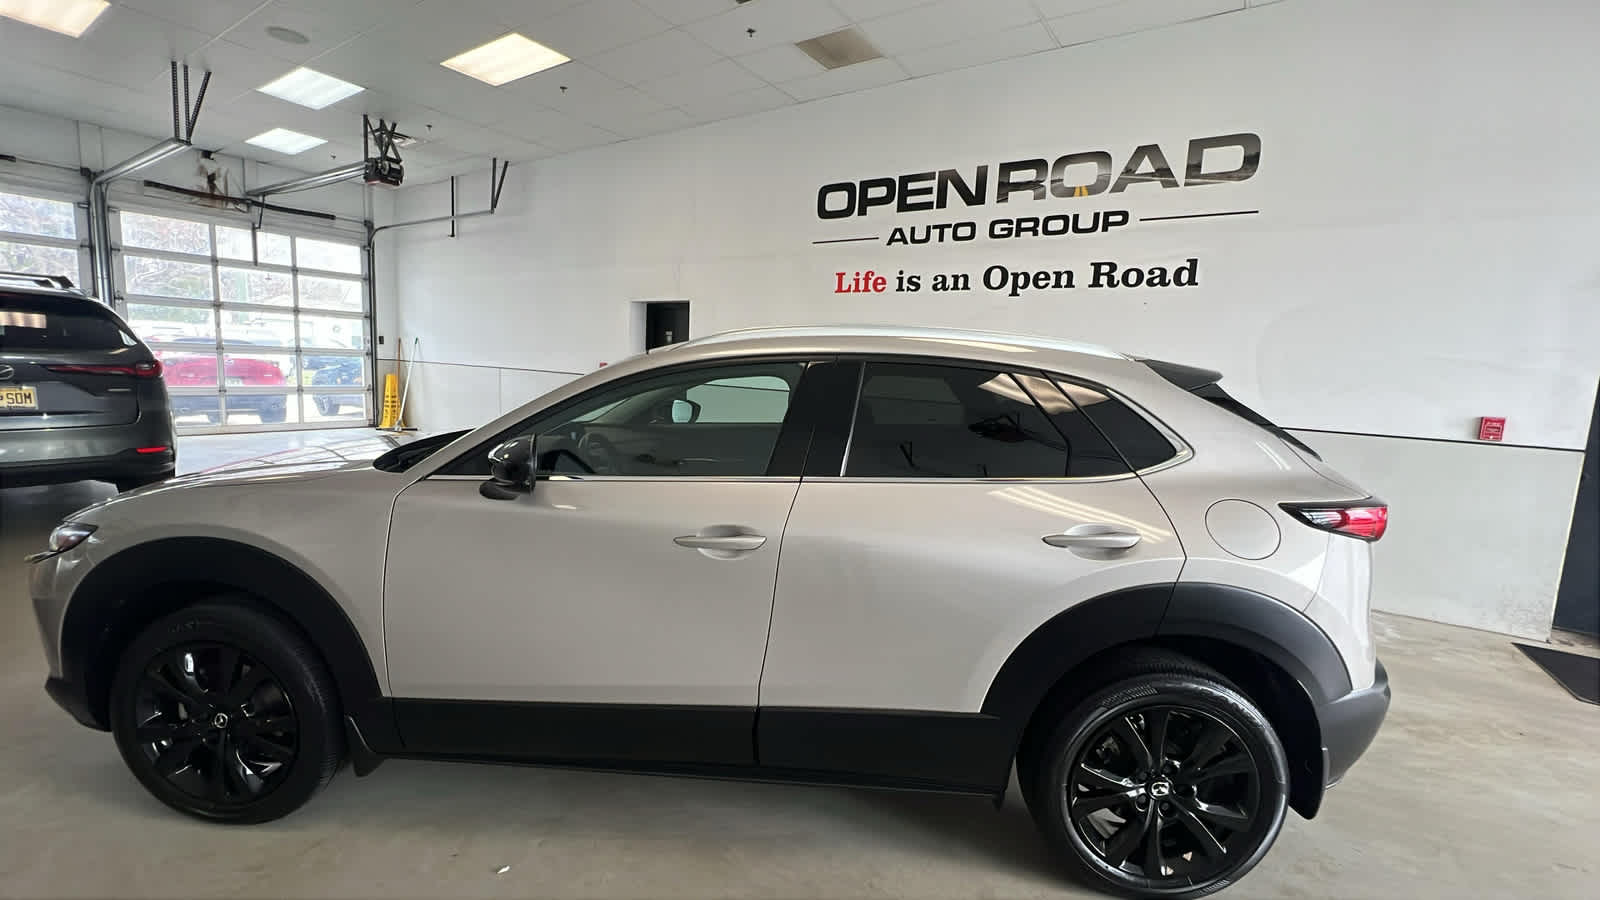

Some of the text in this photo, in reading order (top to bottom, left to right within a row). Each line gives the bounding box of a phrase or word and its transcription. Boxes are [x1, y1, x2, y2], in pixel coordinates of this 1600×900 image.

[817, 132, 1262, 220] OPEN ROAD
[886, 210, 1130, 246] AUTO GROUP
[834, 257, 1199, 298] Life is an Open Road
